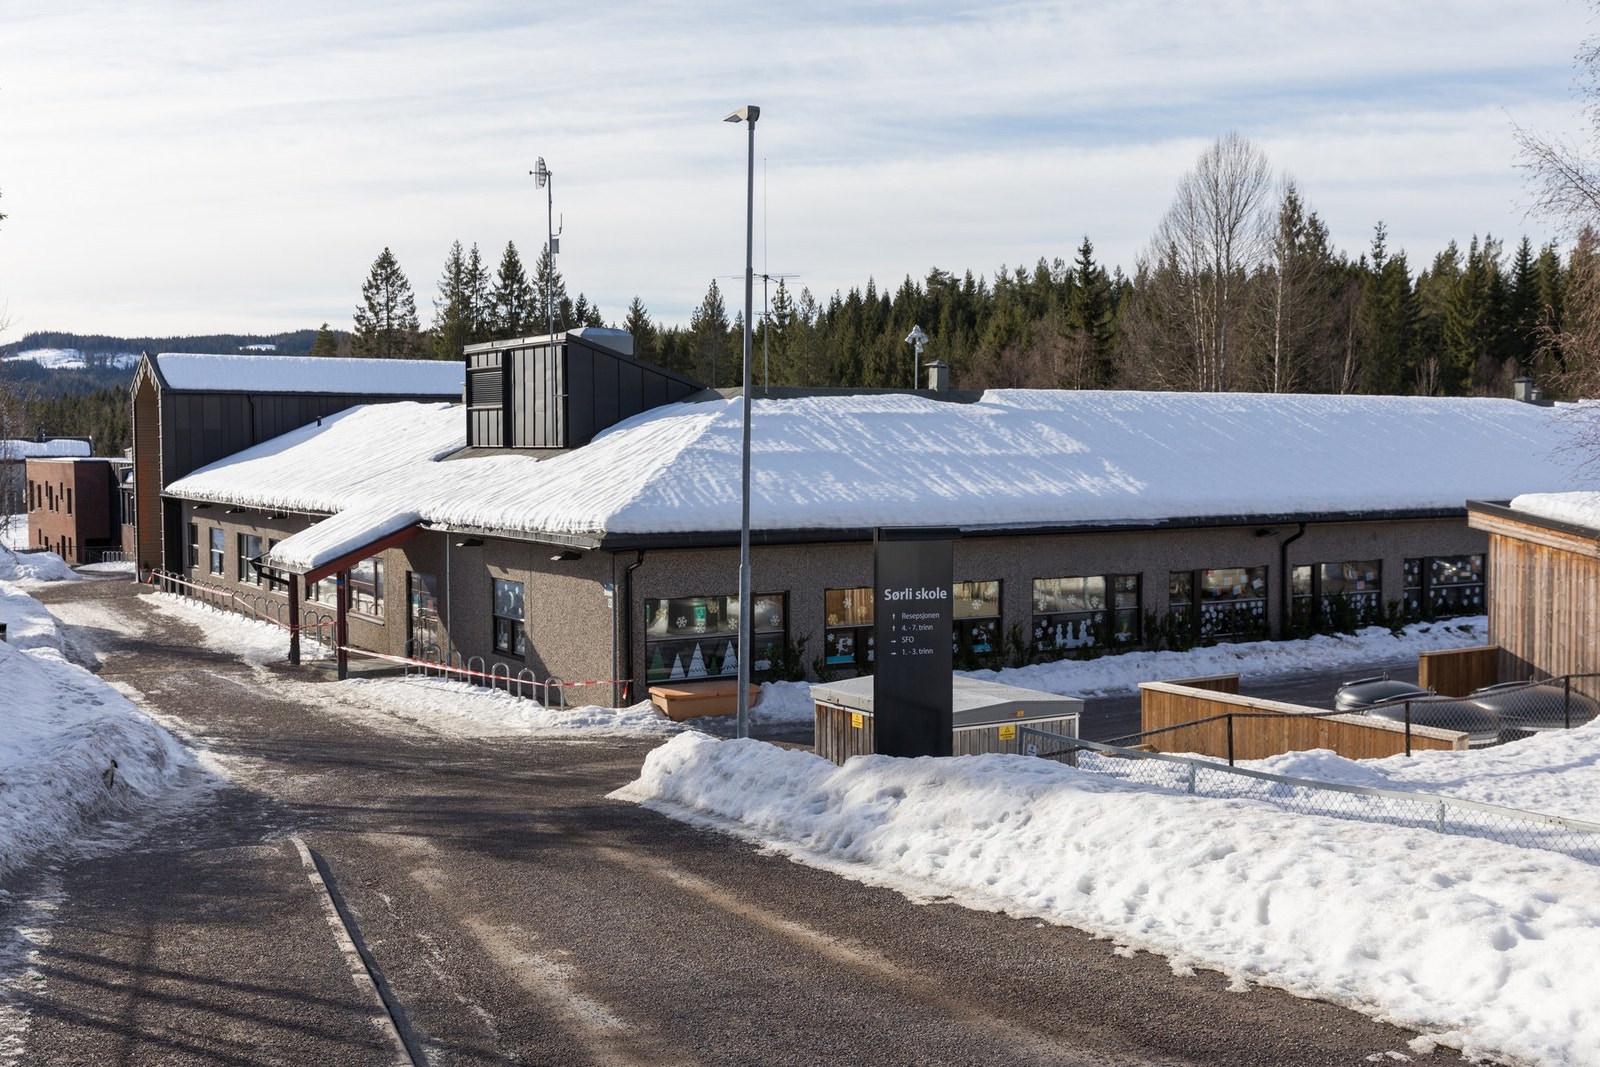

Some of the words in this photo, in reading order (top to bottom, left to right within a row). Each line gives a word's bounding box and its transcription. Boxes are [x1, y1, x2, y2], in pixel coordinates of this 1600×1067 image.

[884, 588, 912, 600] Sørli
[915, 587, 947, 599] skole
[901, 612, 940, 620] Resepsjonen
